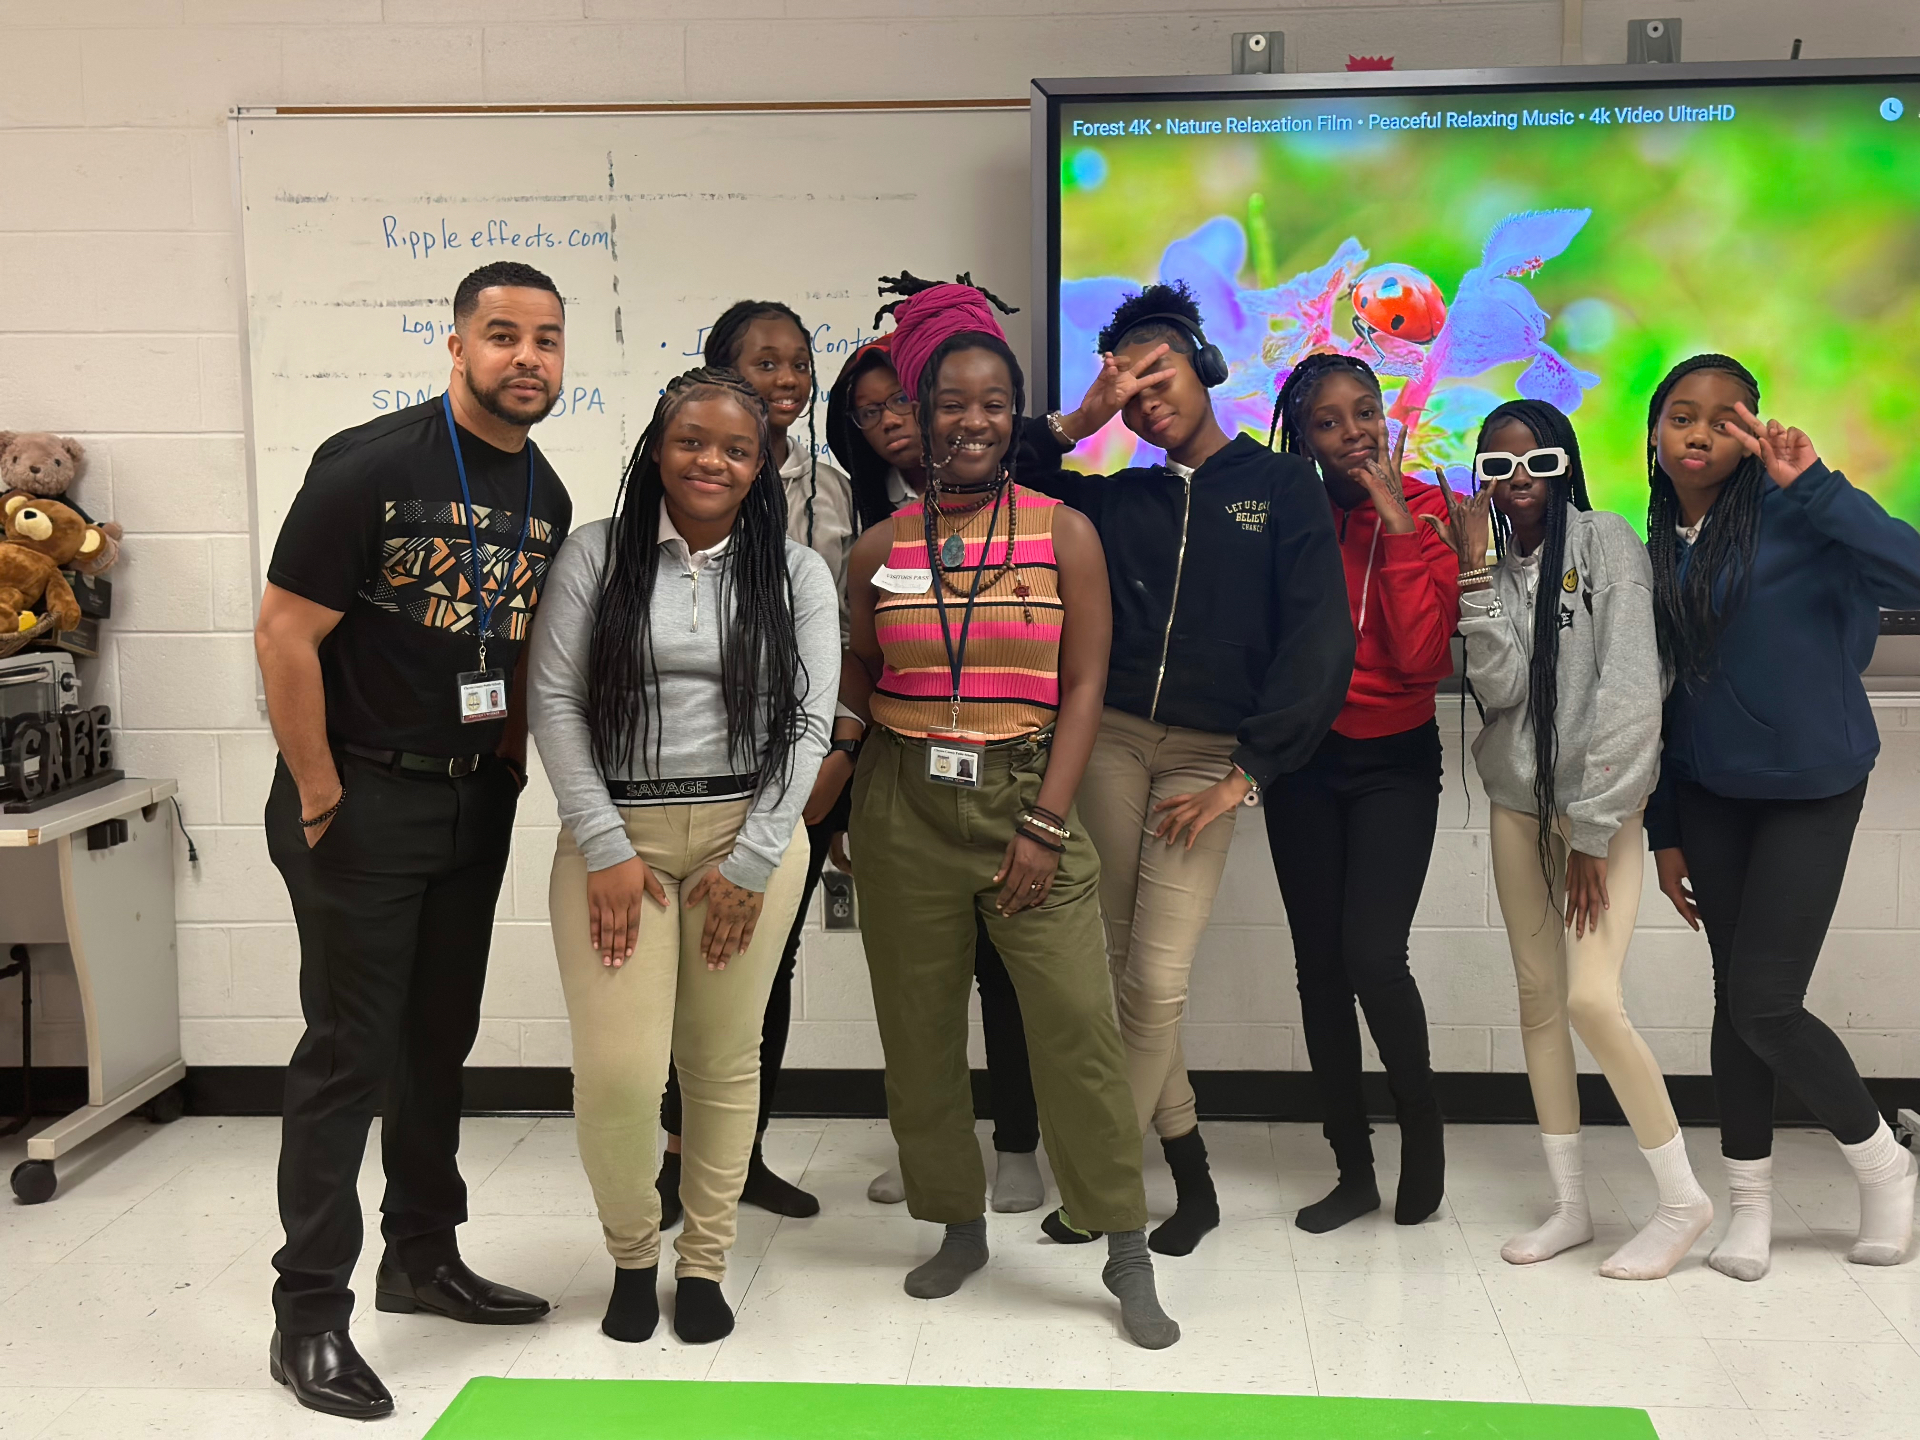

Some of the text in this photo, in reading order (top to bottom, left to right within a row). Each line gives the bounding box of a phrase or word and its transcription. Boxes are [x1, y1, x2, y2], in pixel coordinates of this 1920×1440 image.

[1072, 104, 1736, 136] Forest 4K Nature Relaxation Film Peaceful Relaxing Music 4k Video UltraHD
[383, 215, 462, 260] Ripple
[1225, 502, 1242, 513] LET
[1244, 501, 1257, 510] US
[626, 780, 709, 797] SAVAGE
